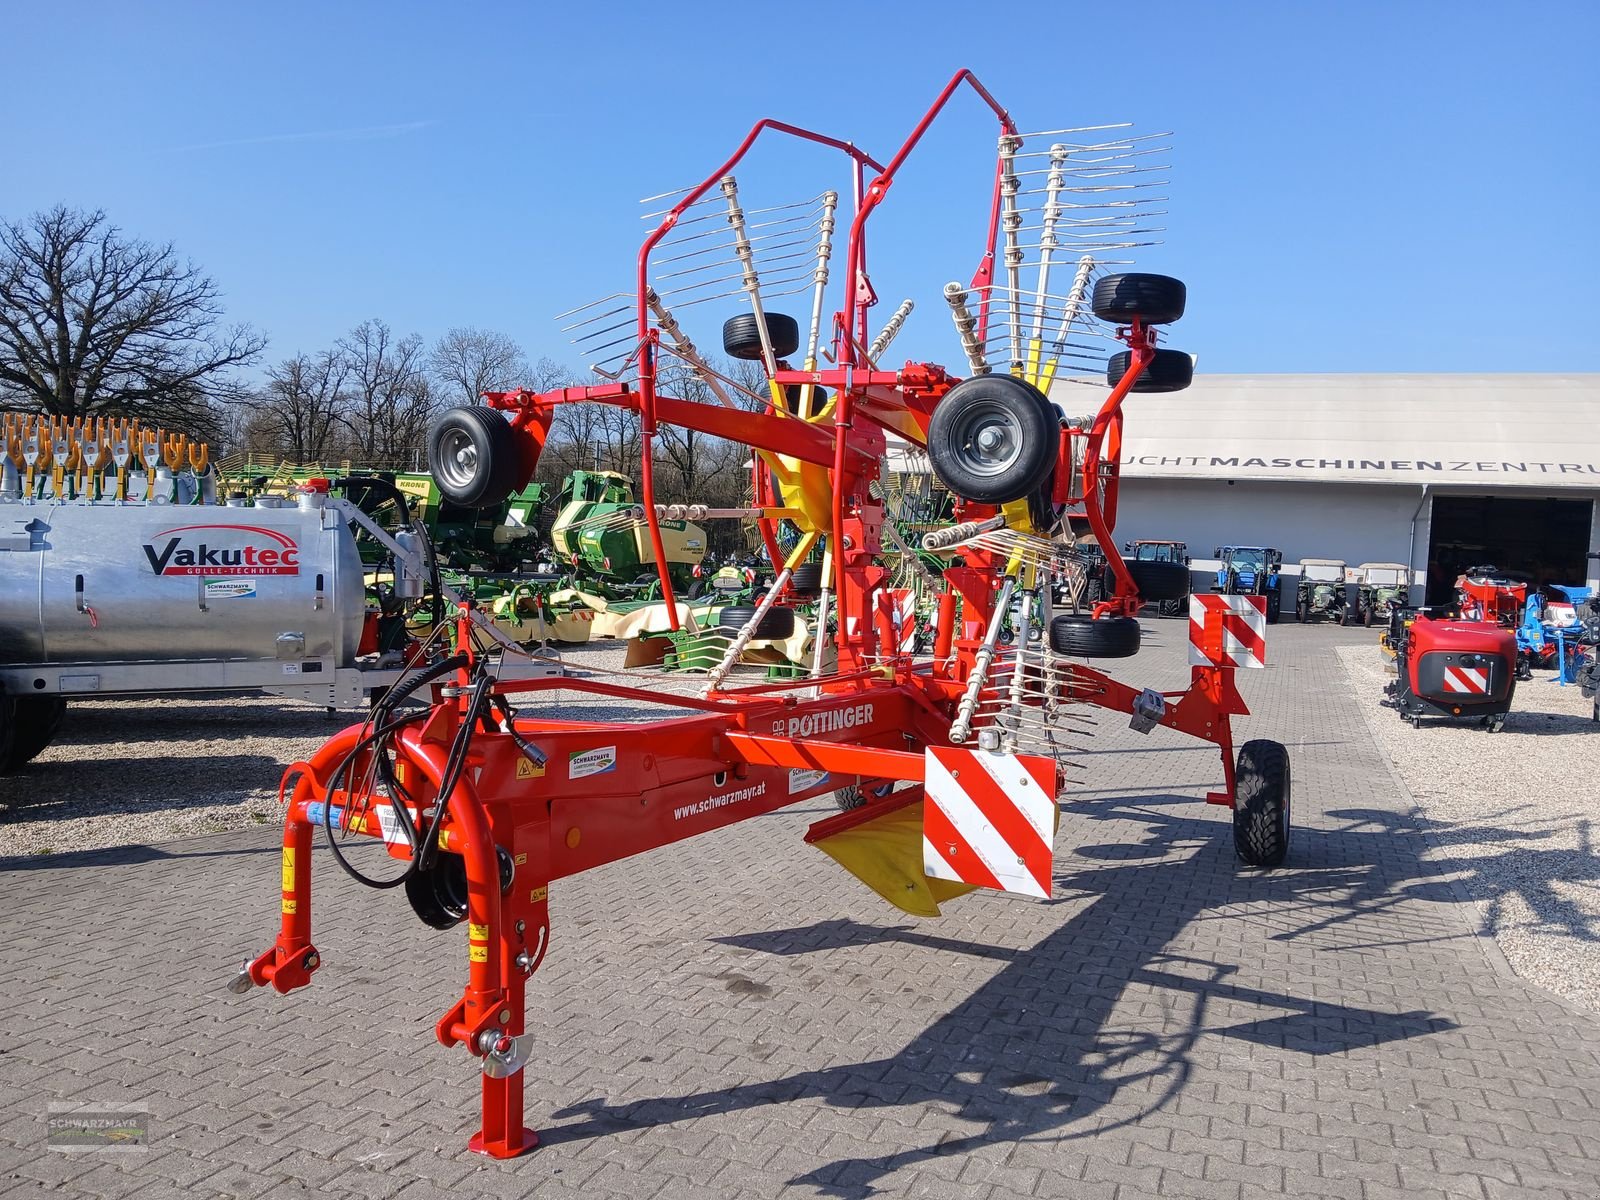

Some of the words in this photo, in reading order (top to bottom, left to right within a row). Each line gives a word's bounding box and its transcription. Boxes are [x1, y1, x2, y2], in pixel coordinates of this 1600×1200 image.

[142, 537, 299, 576] Vakutec
[788, 703, 874, 739] PÖTTINGER
[573, 752, 610, 765] SCHWARZMAYR
[673, 780, 767, 821] www.schwarzmayr.at
